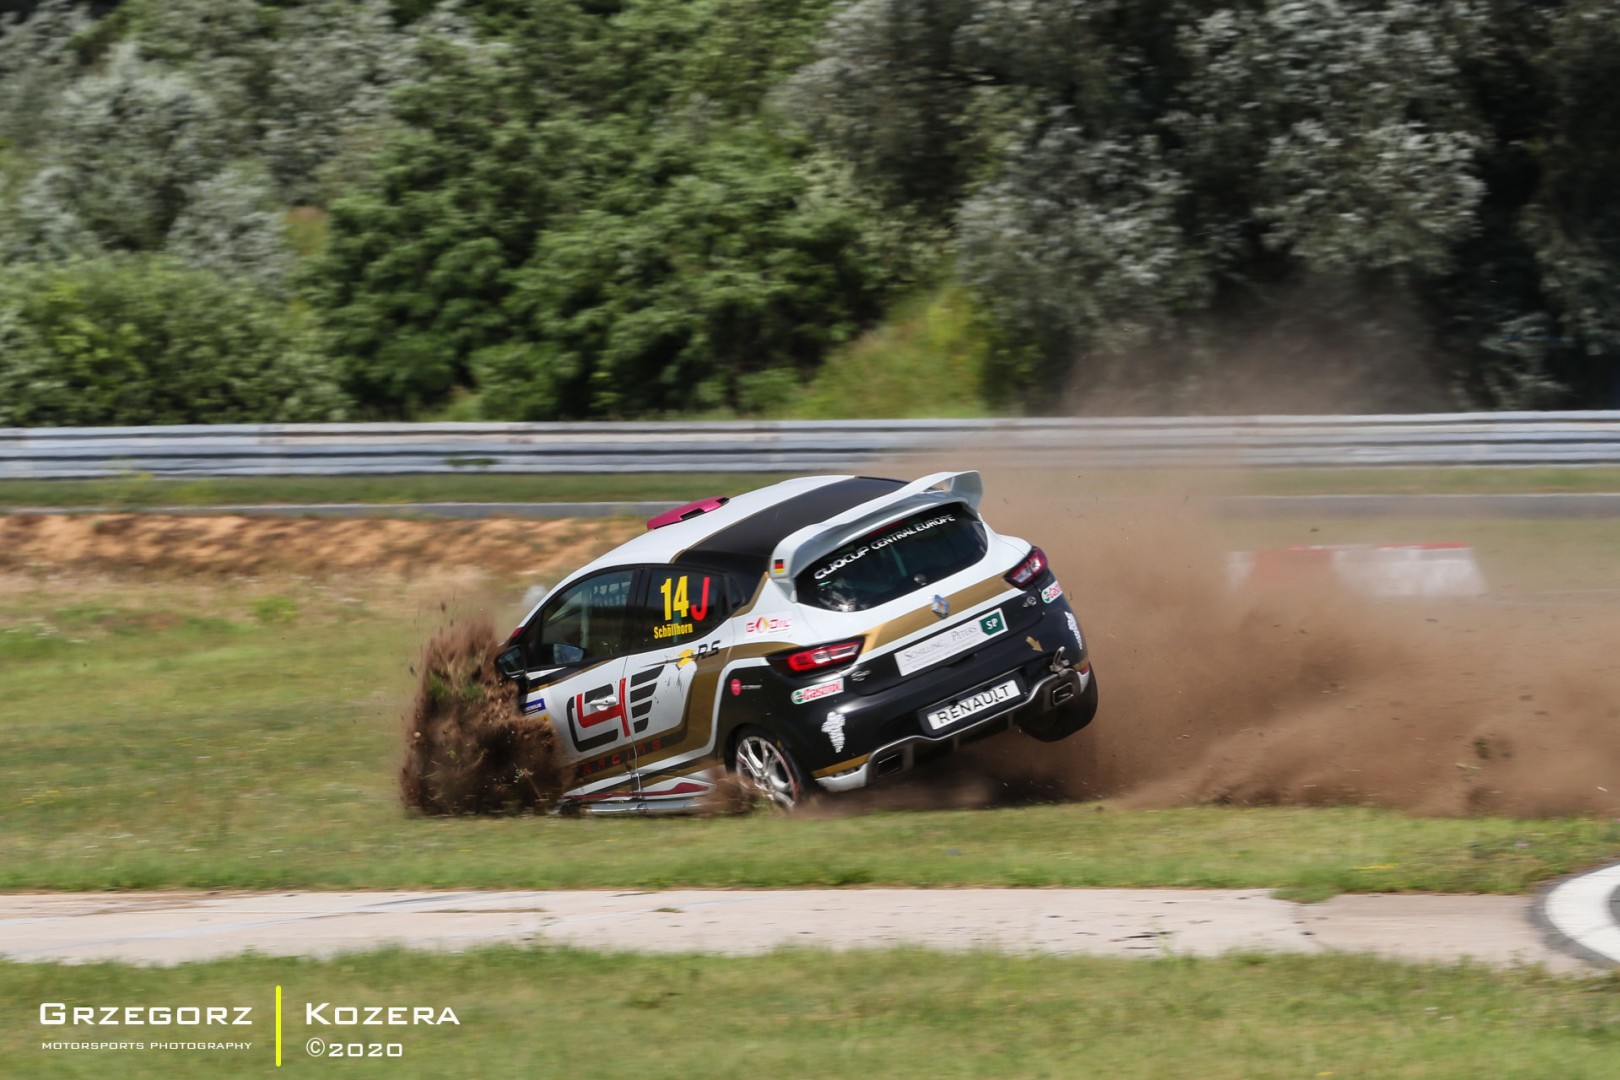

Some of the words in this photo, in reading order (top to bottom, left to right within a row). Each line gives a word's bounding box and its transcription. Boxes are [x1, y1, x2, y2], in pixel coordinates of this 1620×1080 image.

[814, 546, 870, 580] CLIOCUP
[871, 527, 917, 549] CENTRAL
[915, 514, 956, 531] EUROPE
[660, 575, 690, 621] 14
[690, 576, 711, 621] J
[653, 623, 694, 639] Schöllhorn
[985, 618, 998, 630] SP
[935, 684, 1009, 724] RENAULT
